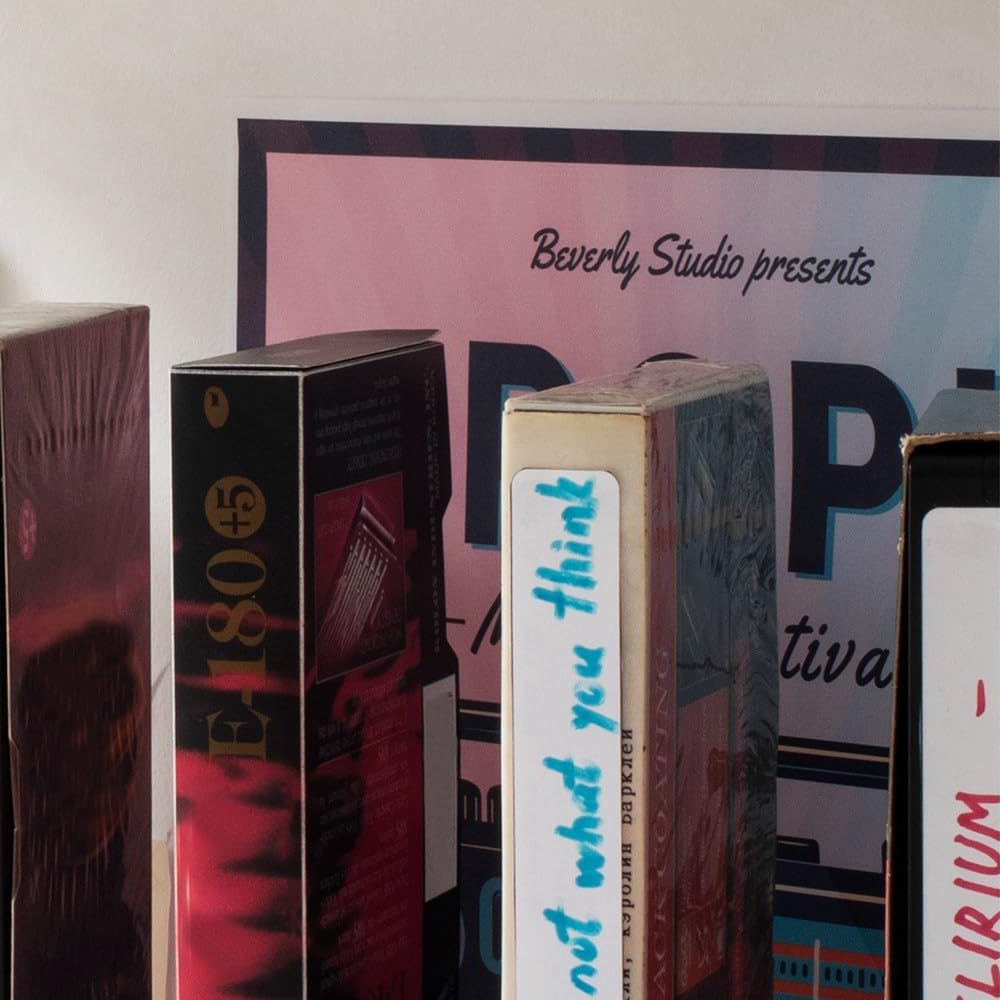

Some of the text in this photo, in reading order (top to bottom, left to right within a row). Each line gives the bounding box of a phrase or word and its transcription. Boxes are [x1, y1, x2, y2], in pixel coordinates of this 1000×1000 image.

[530, 228, 876, 296] Beverly Studio presents
[532, 474, 600, 620] think
[571, 645, 617, 733] you
[653, 648, 672, 879] COATING
[543, 756, 606, 889] what
[543, 907, 603, 997] not
